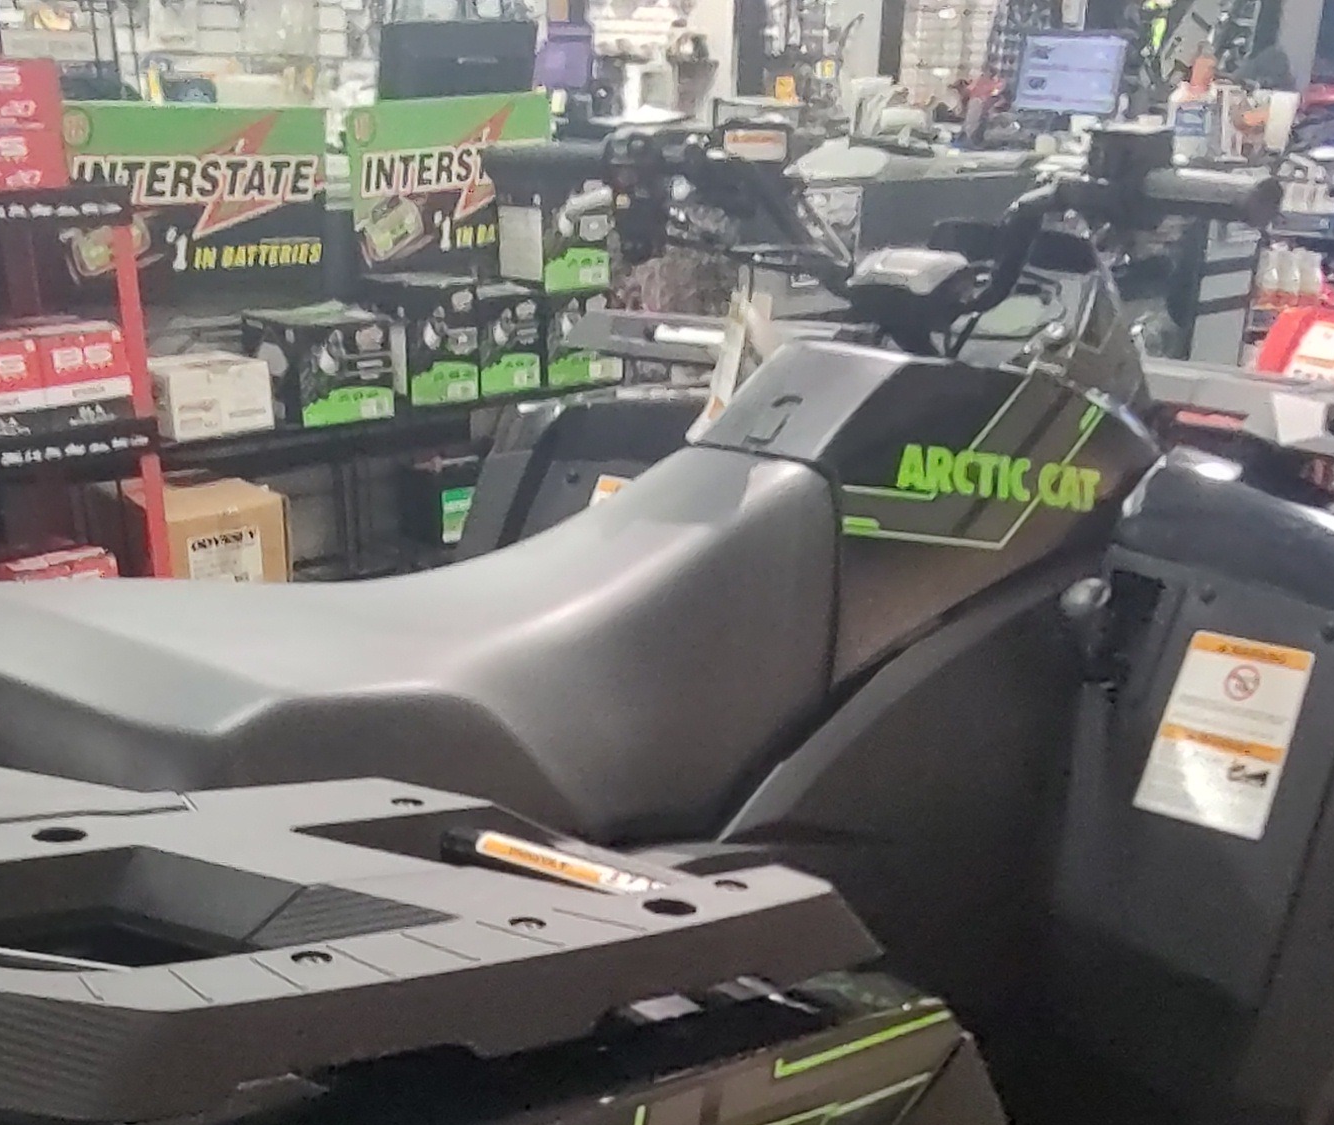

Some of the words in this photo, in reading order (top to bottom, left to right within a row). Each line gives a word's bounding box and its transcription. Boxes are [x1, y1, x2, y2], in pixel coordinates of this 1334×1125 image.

[220, 242, 323, 269] BATTERIES
[897, 443, 1029, 501] ARCTIC
[1036, 463, 1102, 512] CAT
